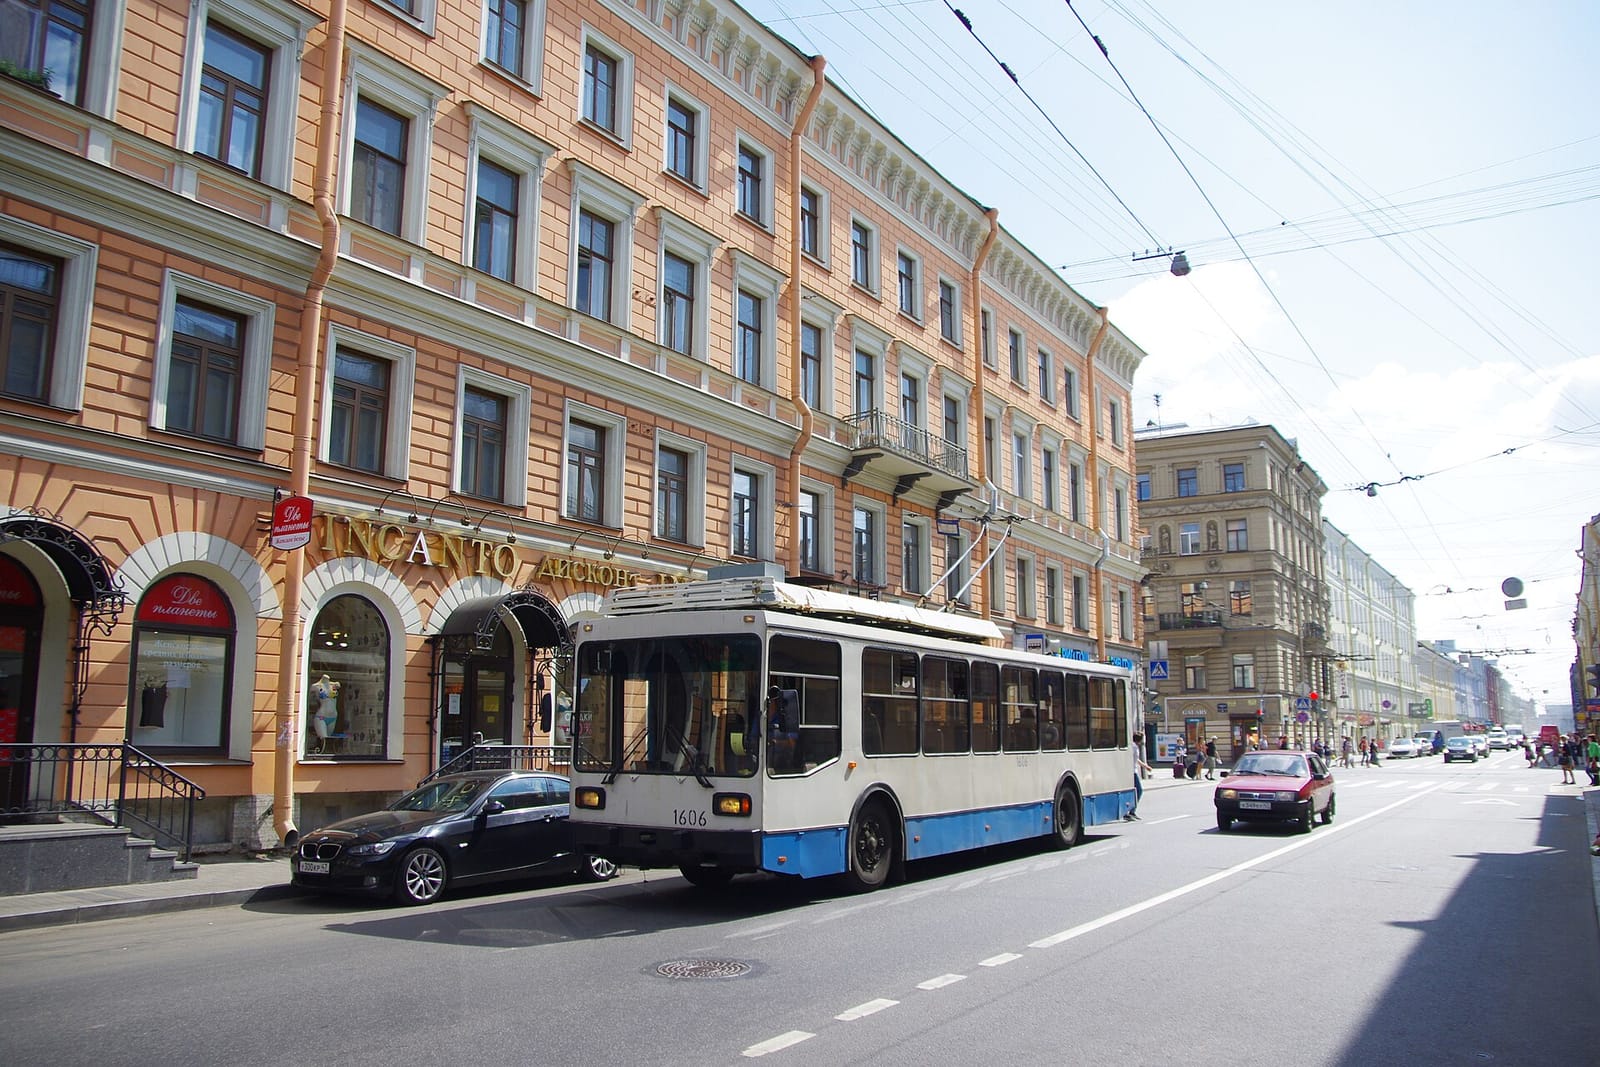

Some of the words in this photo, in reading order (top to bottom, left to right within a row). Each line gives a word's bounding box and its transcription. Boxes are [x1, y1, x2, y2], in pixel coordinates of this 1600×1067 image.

[322, 513, 519, 577] INCANTO
[538, 555, 642, 588] ДИСКОНТ
[171, 585, 202, 606] Две
[152, 605, 218, 619] планеты
[673, 809, 707, 826] 1606
